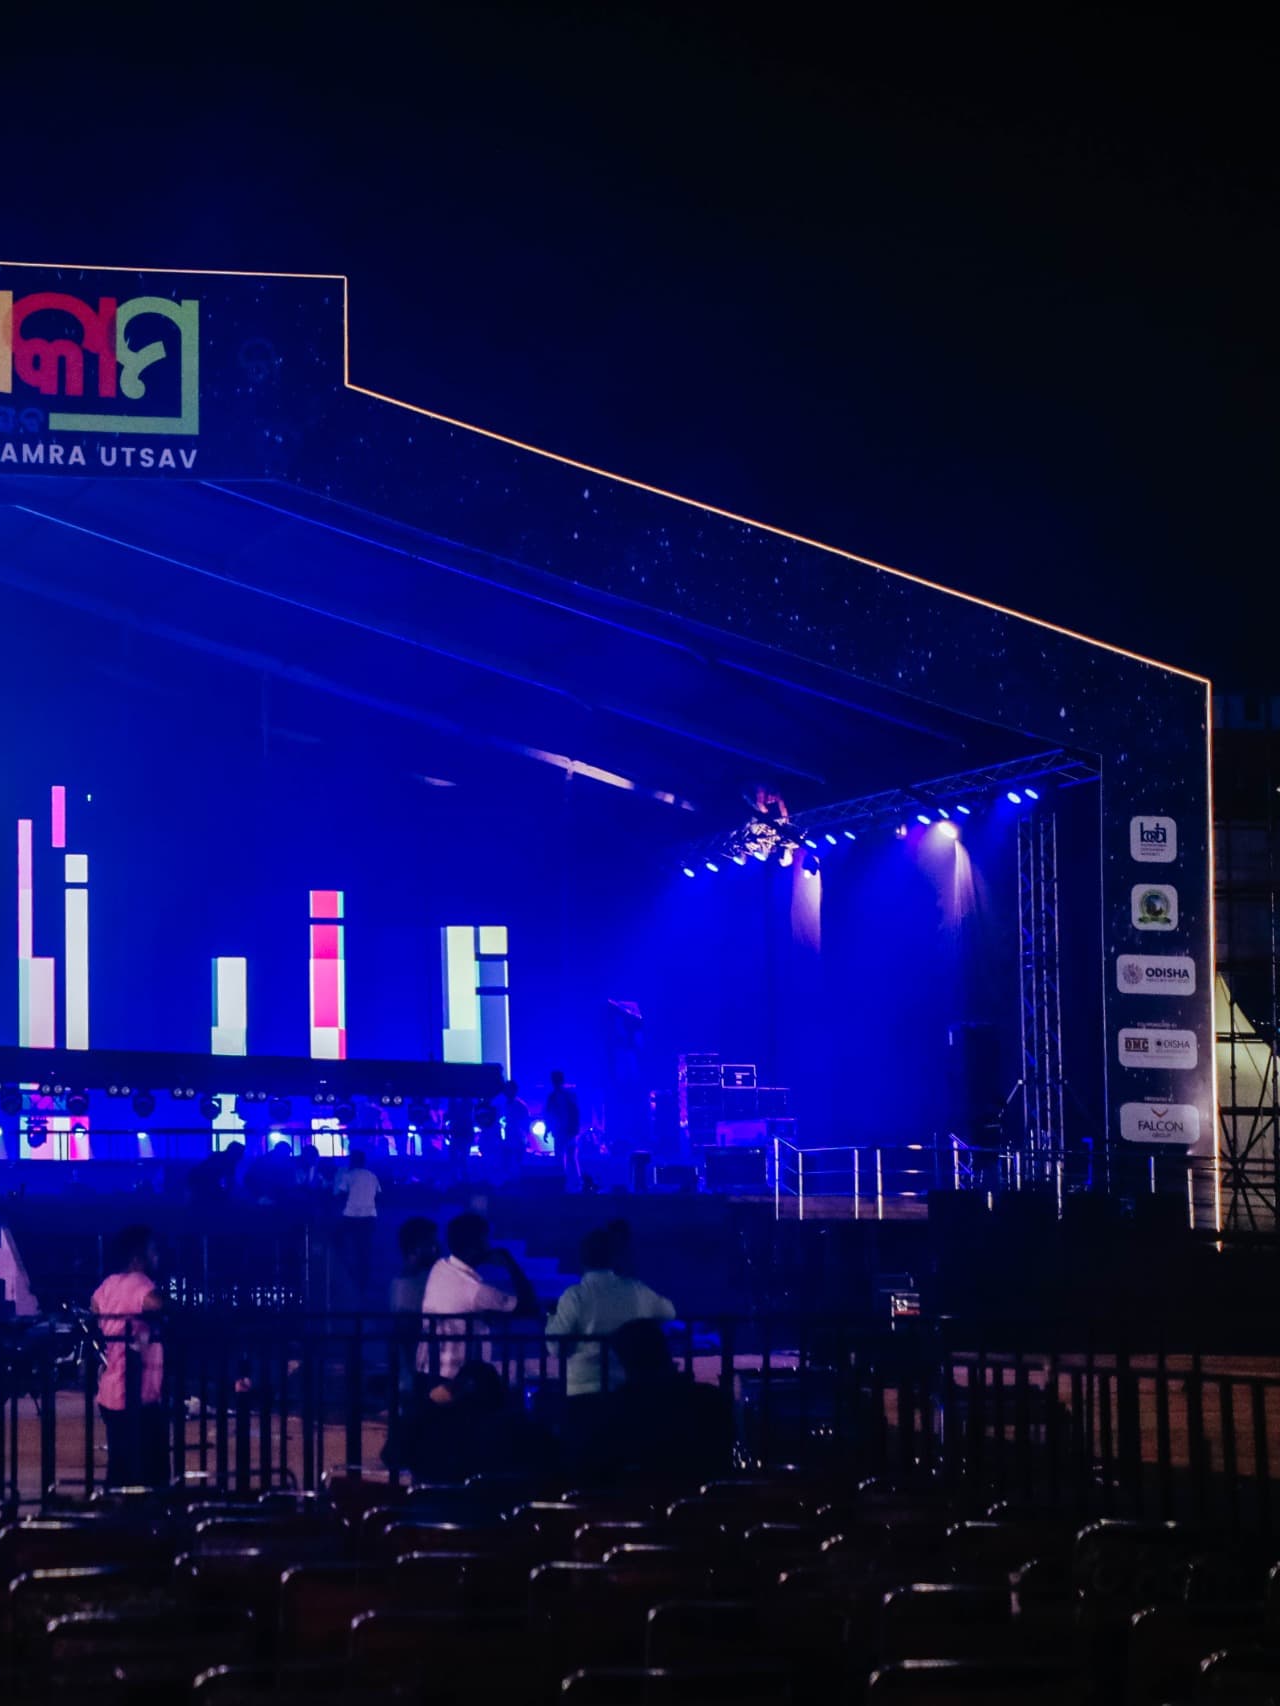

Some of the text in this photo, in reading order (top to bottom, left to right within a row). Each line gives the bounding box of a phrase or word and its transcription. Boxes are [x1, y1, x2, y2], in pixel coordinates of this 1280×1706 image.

[100, 446, 197, 469] UTSAV
[1145, 967, 1190, 979] ODISHA
[1138, 1120, 1184, 1133] FALCON
